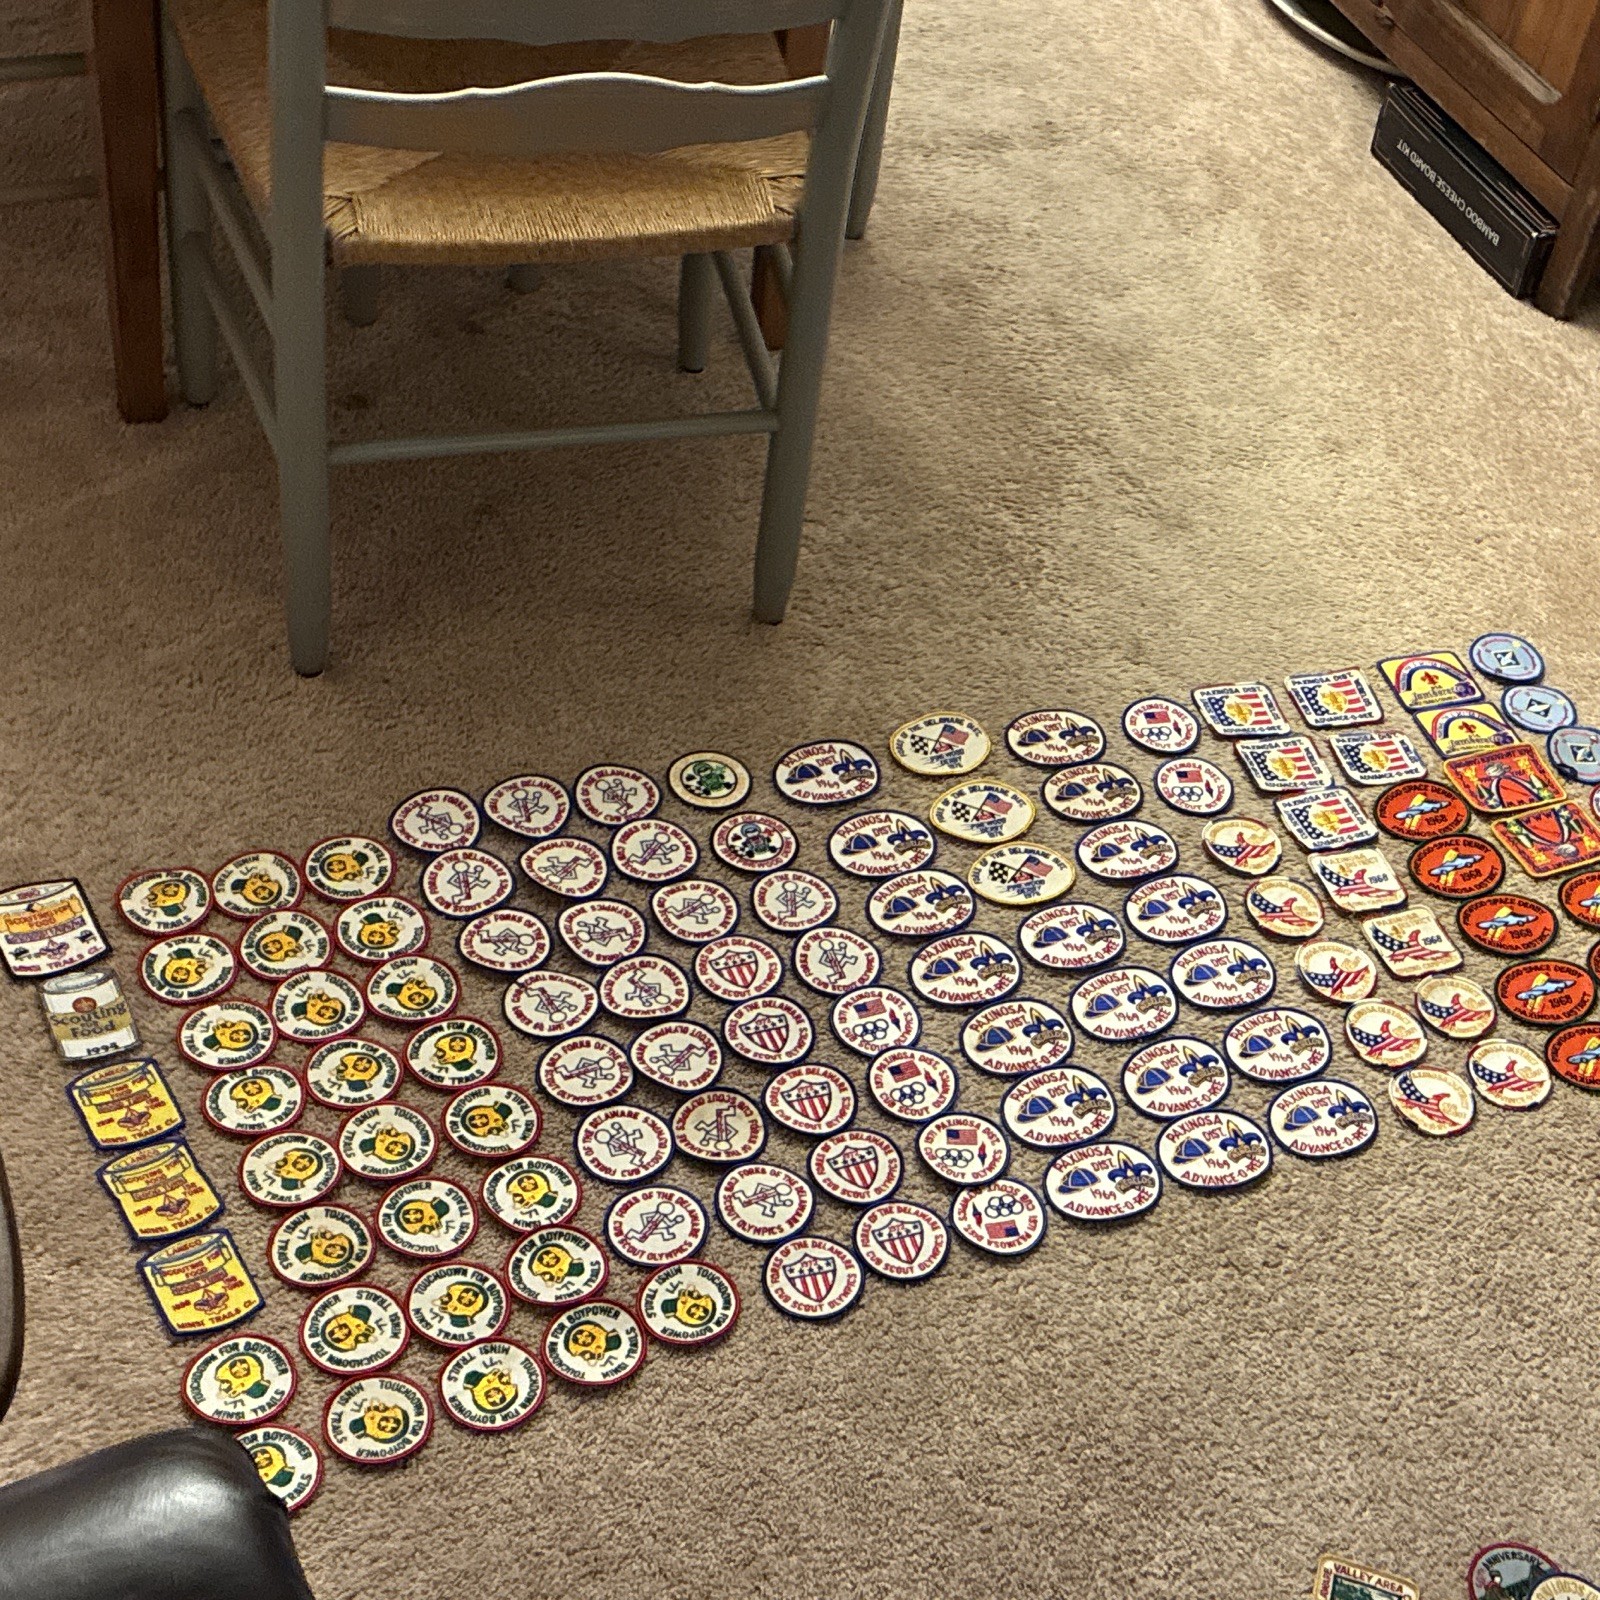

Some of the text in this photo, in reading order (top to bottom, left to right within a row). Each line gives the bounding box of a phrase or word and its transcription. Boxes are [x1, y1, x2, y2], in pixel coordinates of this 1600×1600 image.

[1396, 138, 1500, 246] BAMBOO CHEESE BOARD KIT
[1025, 906, 1079, 931] PAXINOSA
[918, 936, 977, 962] PAXINOSA
[1177, 944, 1230, 969] PAXINOSA
[1078, 972, 1130, 999] PAXINOSA
[52, 1002, 126, 1025] Scouting
[969, 1003, 1027, 1032] PAXINOSA
[1229, 1011, 1283, 1041] PAXINOSA
[70, 1019, 116, 1037] Food
[1127, 1043, 1180, 1075] PAXINOSA
[1010, 1071, 1069, 1101] PAXINOSA
[1276, 1085, 1333, 1111] PAXINOSA
[1166, 1114, 1223, 1144] PAXINOSA
[1053, 1145, 1114, 1172] PAXINOSA
[538, 1229, 591, 1251] BOYPOWER
[566, 1307, 622, 1322] BOYPOWER
[791, 1301, 824, 1312] SCOUT
[250, 1389, 285, 1417] TRAILS
[1482, 1551, 1543, 1571] ANNIVERSARY
[1334, 1563, 1374, 1583] VALLEY
[1375, 1578, 1403, 1593] AREA
